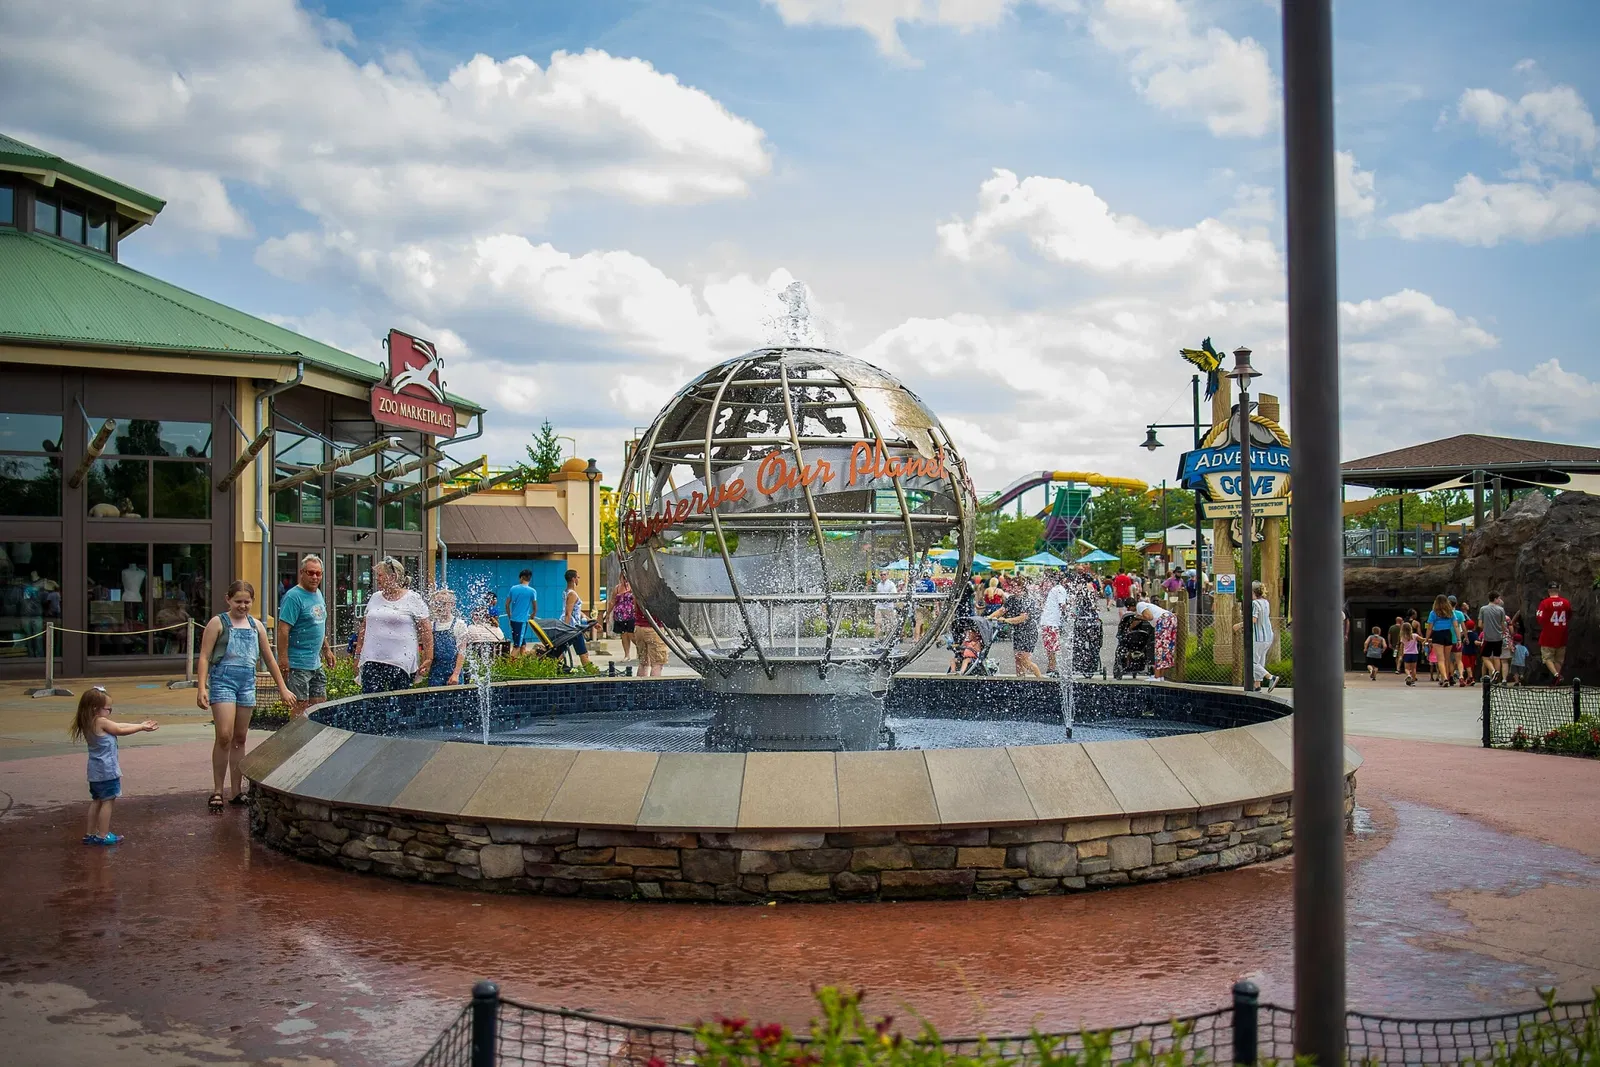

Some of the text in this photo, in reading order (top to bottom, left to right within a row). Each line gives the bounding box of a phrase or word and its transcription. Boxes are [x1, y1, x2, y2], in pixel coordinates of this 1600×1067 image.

[380, 397, 452, 428] ZOO MARKETPLACE
[1194, 451, 1290, 471] ADVENTUR
[625, 478, 747, 552] Conserve
[756, 450, 835, 495] Our
[850, 439, 949, 486] Planet
[1220, 475, 1276, 497] COVE
[1550, 610, 1567, 626] 44
